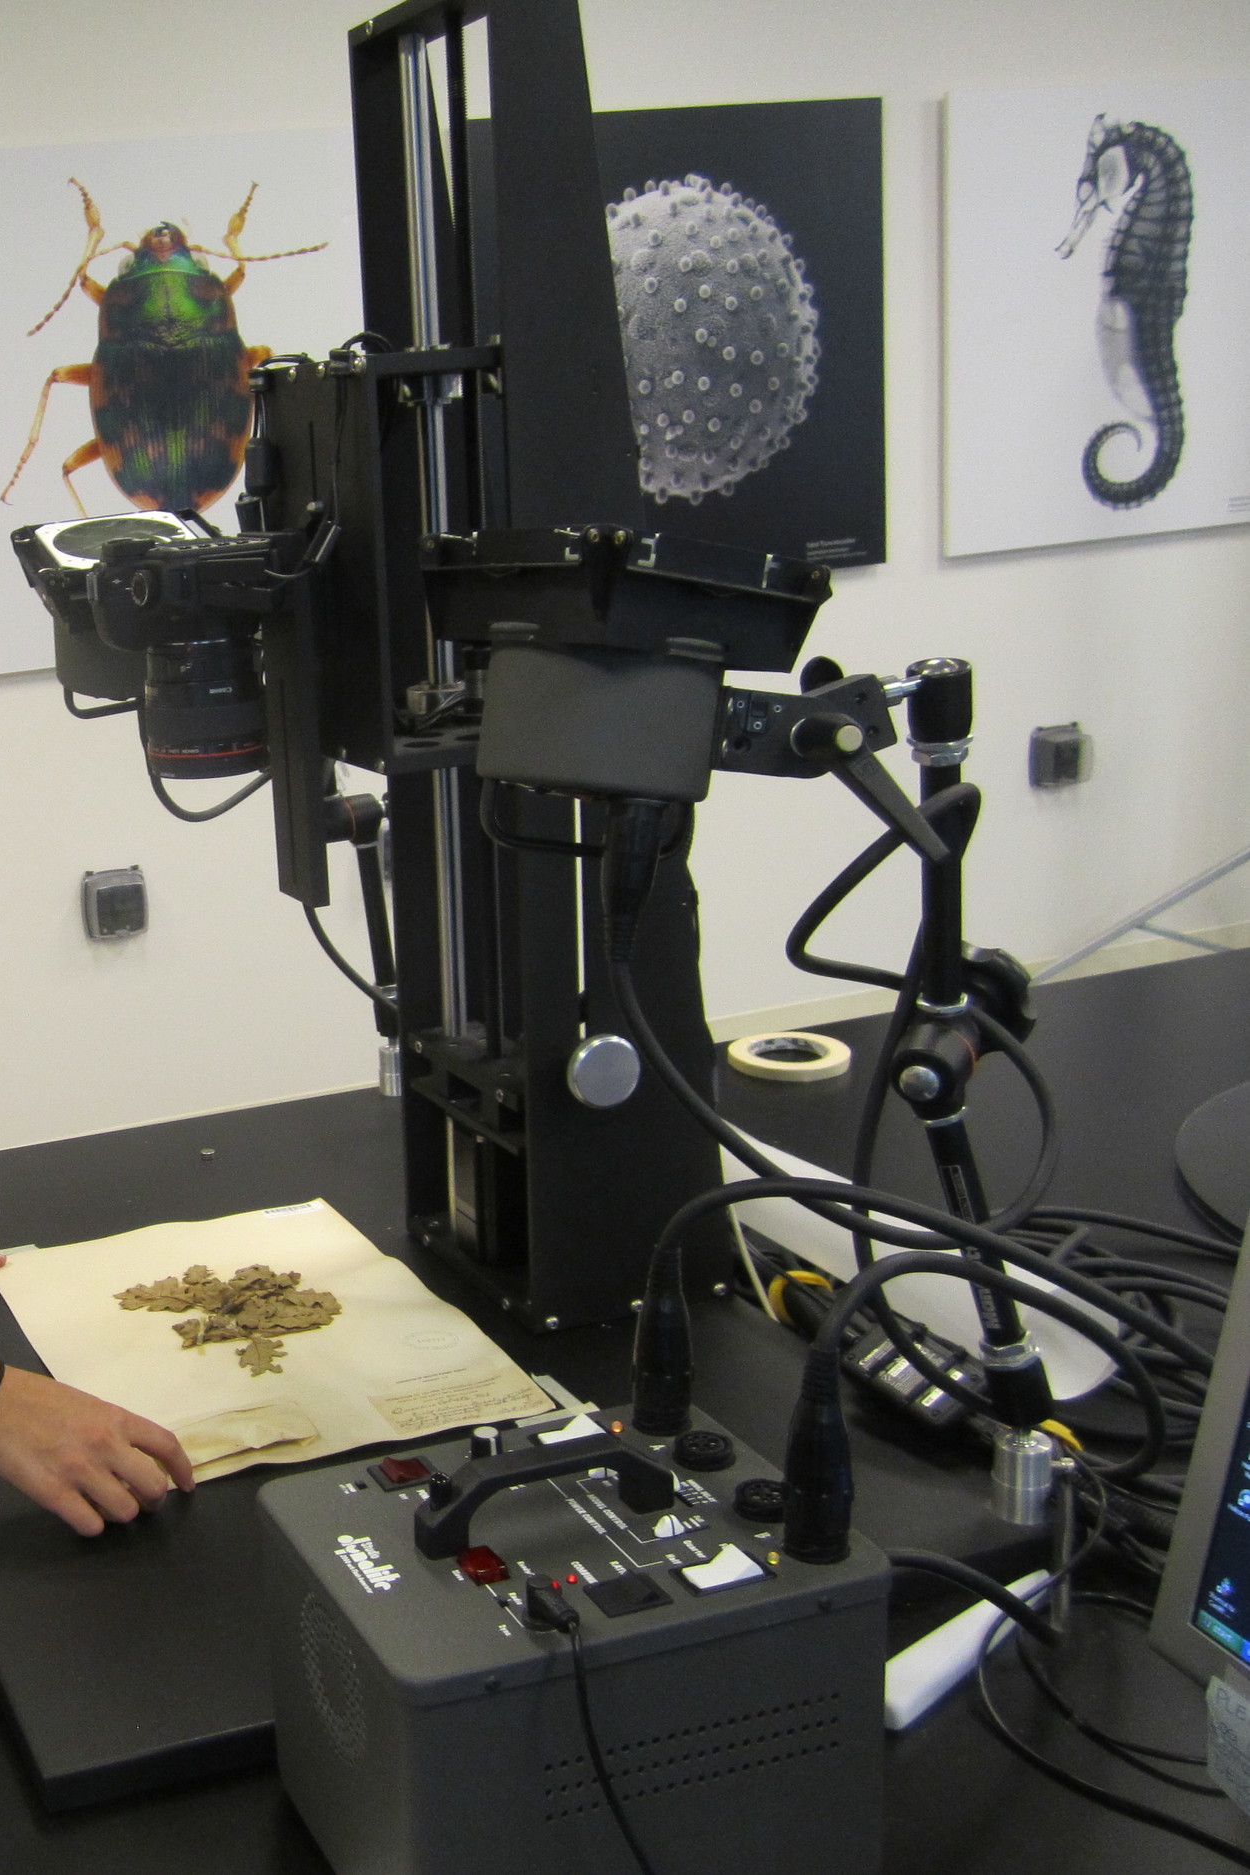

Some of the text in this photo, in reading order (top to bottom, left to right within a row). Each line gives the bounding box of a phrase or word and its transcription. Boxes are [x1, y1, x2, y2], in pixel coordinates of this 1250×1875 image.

[565, 1498, 607, 1534] POWER CONTROL
[586, 1494, 628, 1530] MODEL CONTROL
[360, 1541, 380, 1559] Studio
